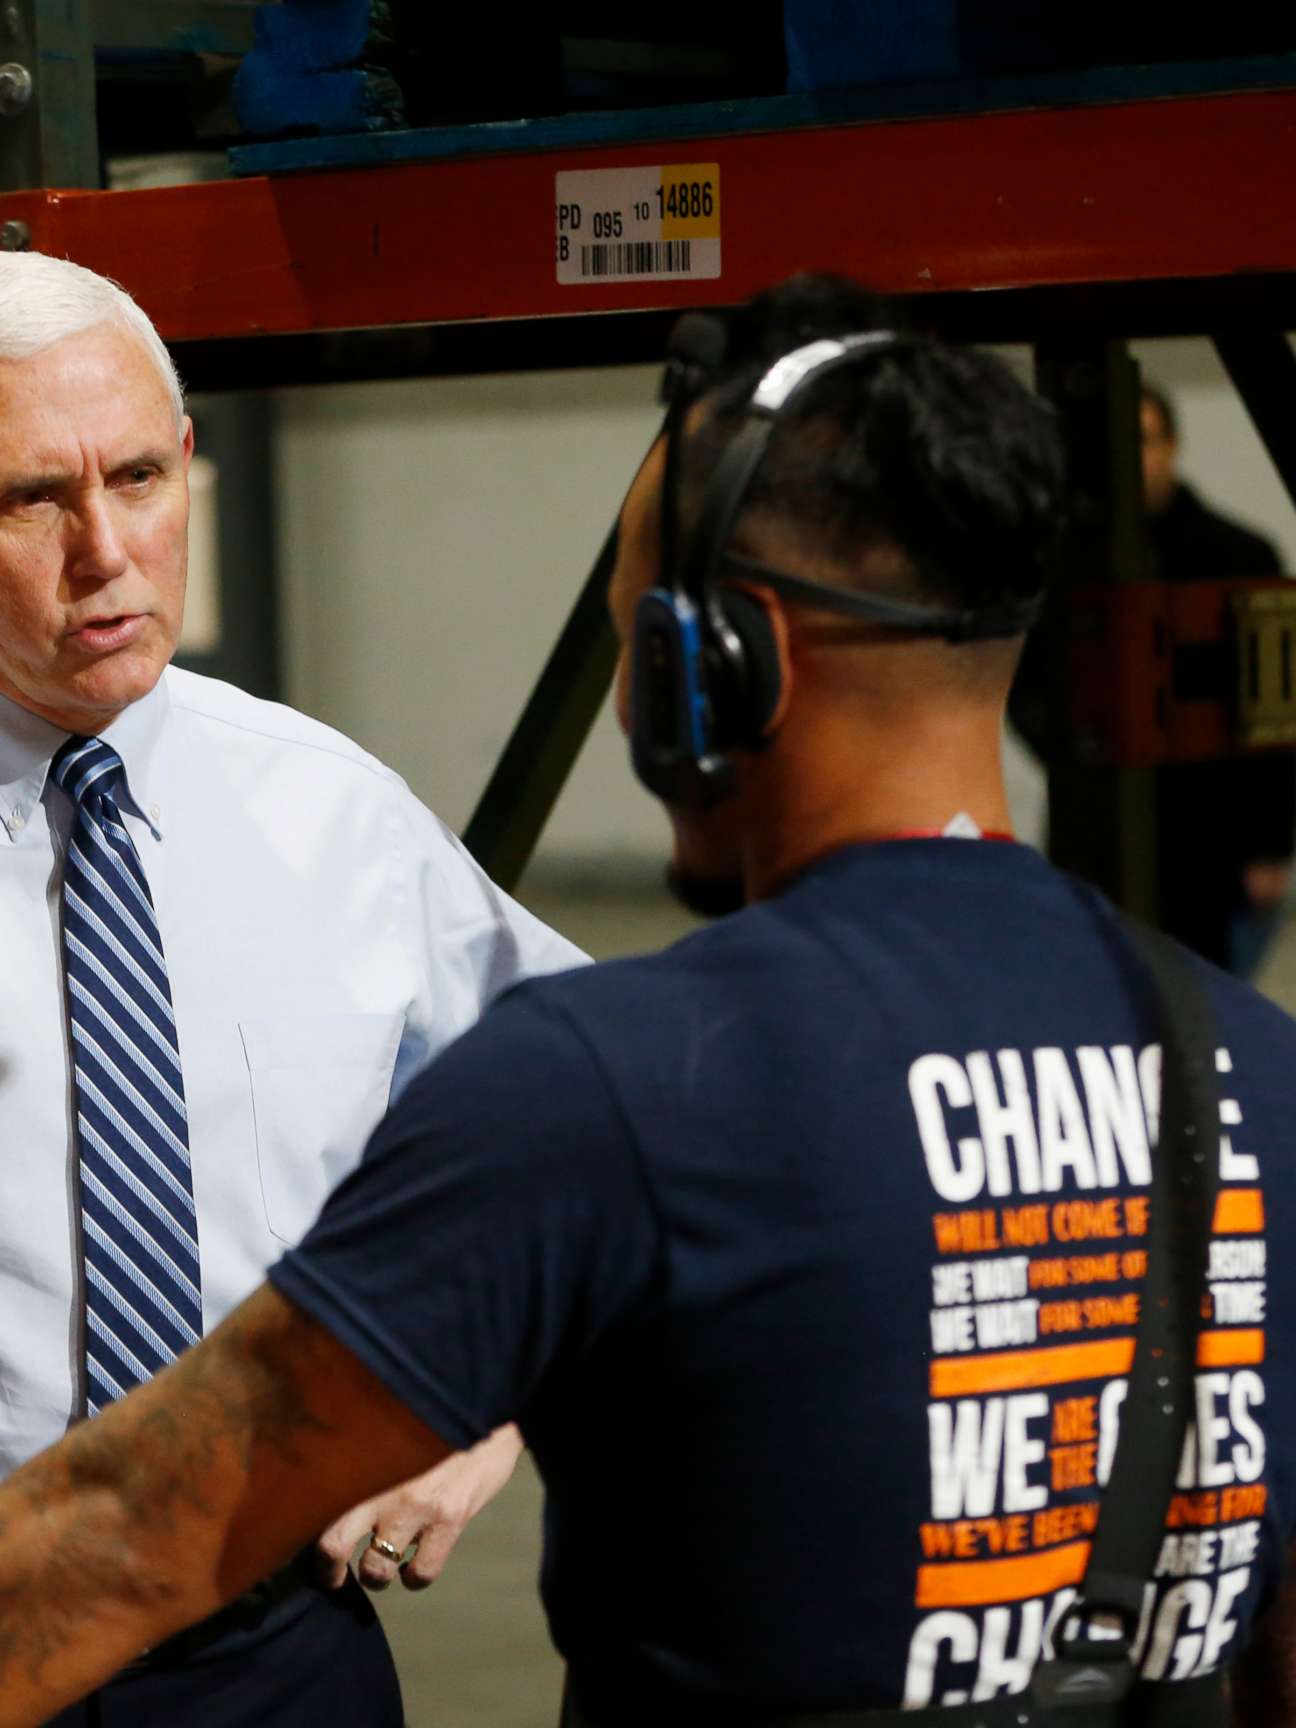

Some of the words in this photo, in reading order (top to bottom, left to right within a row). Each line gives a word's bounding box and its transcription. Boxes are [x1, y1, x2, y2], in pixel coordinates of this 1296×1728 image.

[593, 211, 623, 238] 095
[633, 201, 650, 221] 10
[655, 180, 714, 220] 14886
[933, 1208, 1001, 1254] WILL
[1002, 1204, 1049, 1248] NOT
[1052, 1198, 1122, 1243] COME
[931, 1262, 973, 1306] WE
[972, 1255, 1030, 1301] WAIT
[1208, 1239, 1267, 1280] RSON
[929, 1305, 975, 1353] WE
[974, 1298, 1039, 1349] WAIT
[1209, 1280, 1267, 1324] TIME
[927, 1391, 1049, 1521] WE
[902, 1566, 1251, 1711] CHGE
